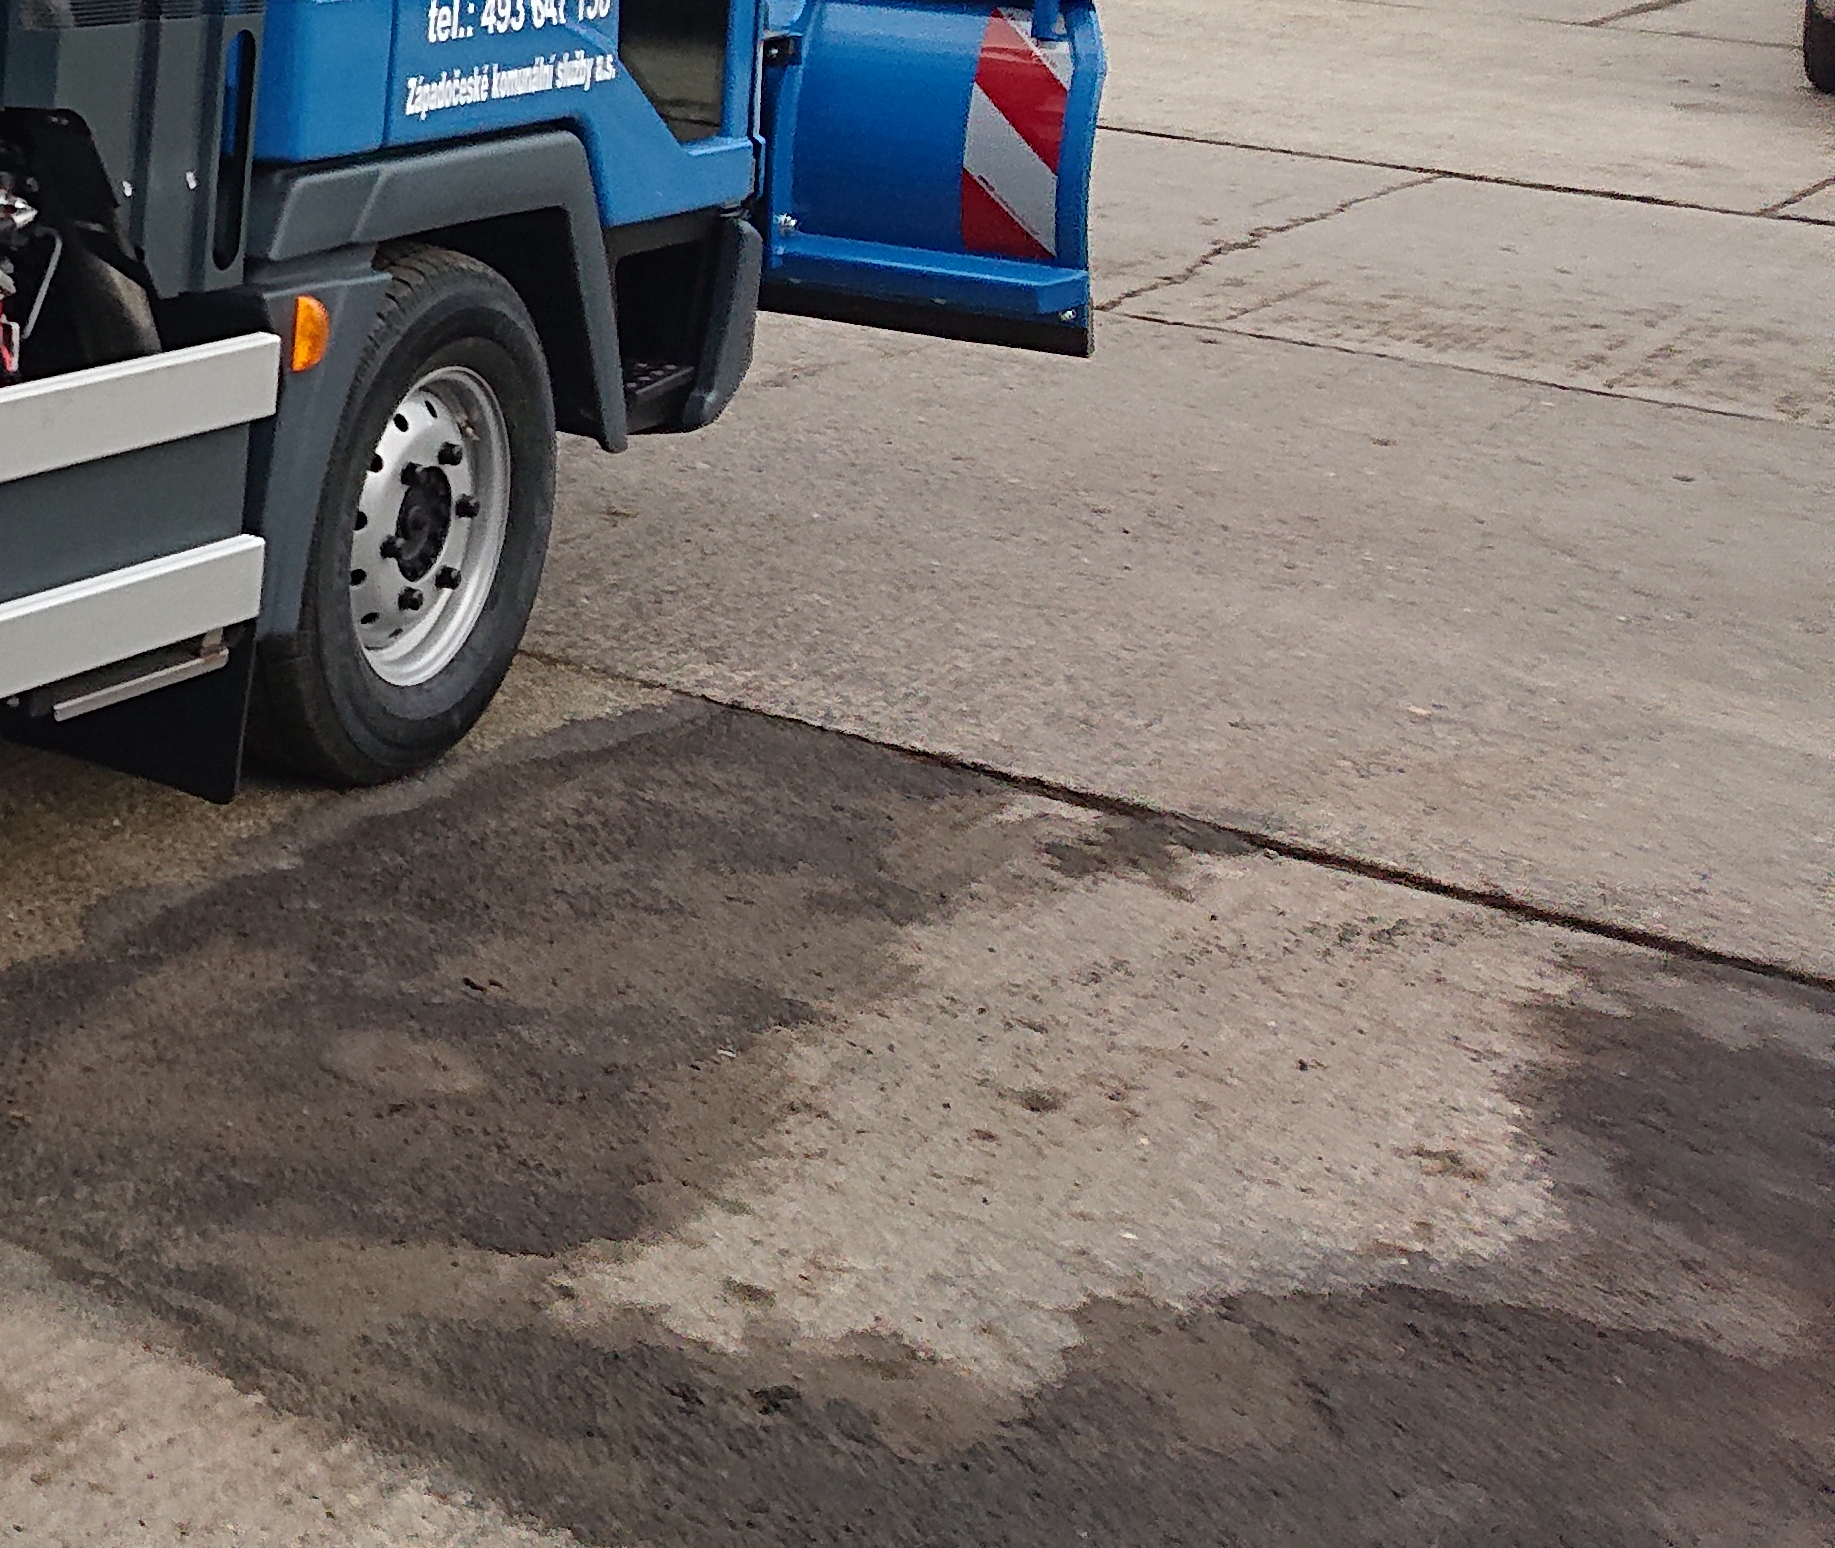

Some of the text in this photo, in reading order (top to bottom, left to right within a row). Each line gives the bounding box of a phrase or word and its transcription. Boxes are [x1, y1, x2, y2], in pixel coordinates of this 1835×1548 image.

[405, 49, 617, 121] Západočeské komunální služby a.s.
